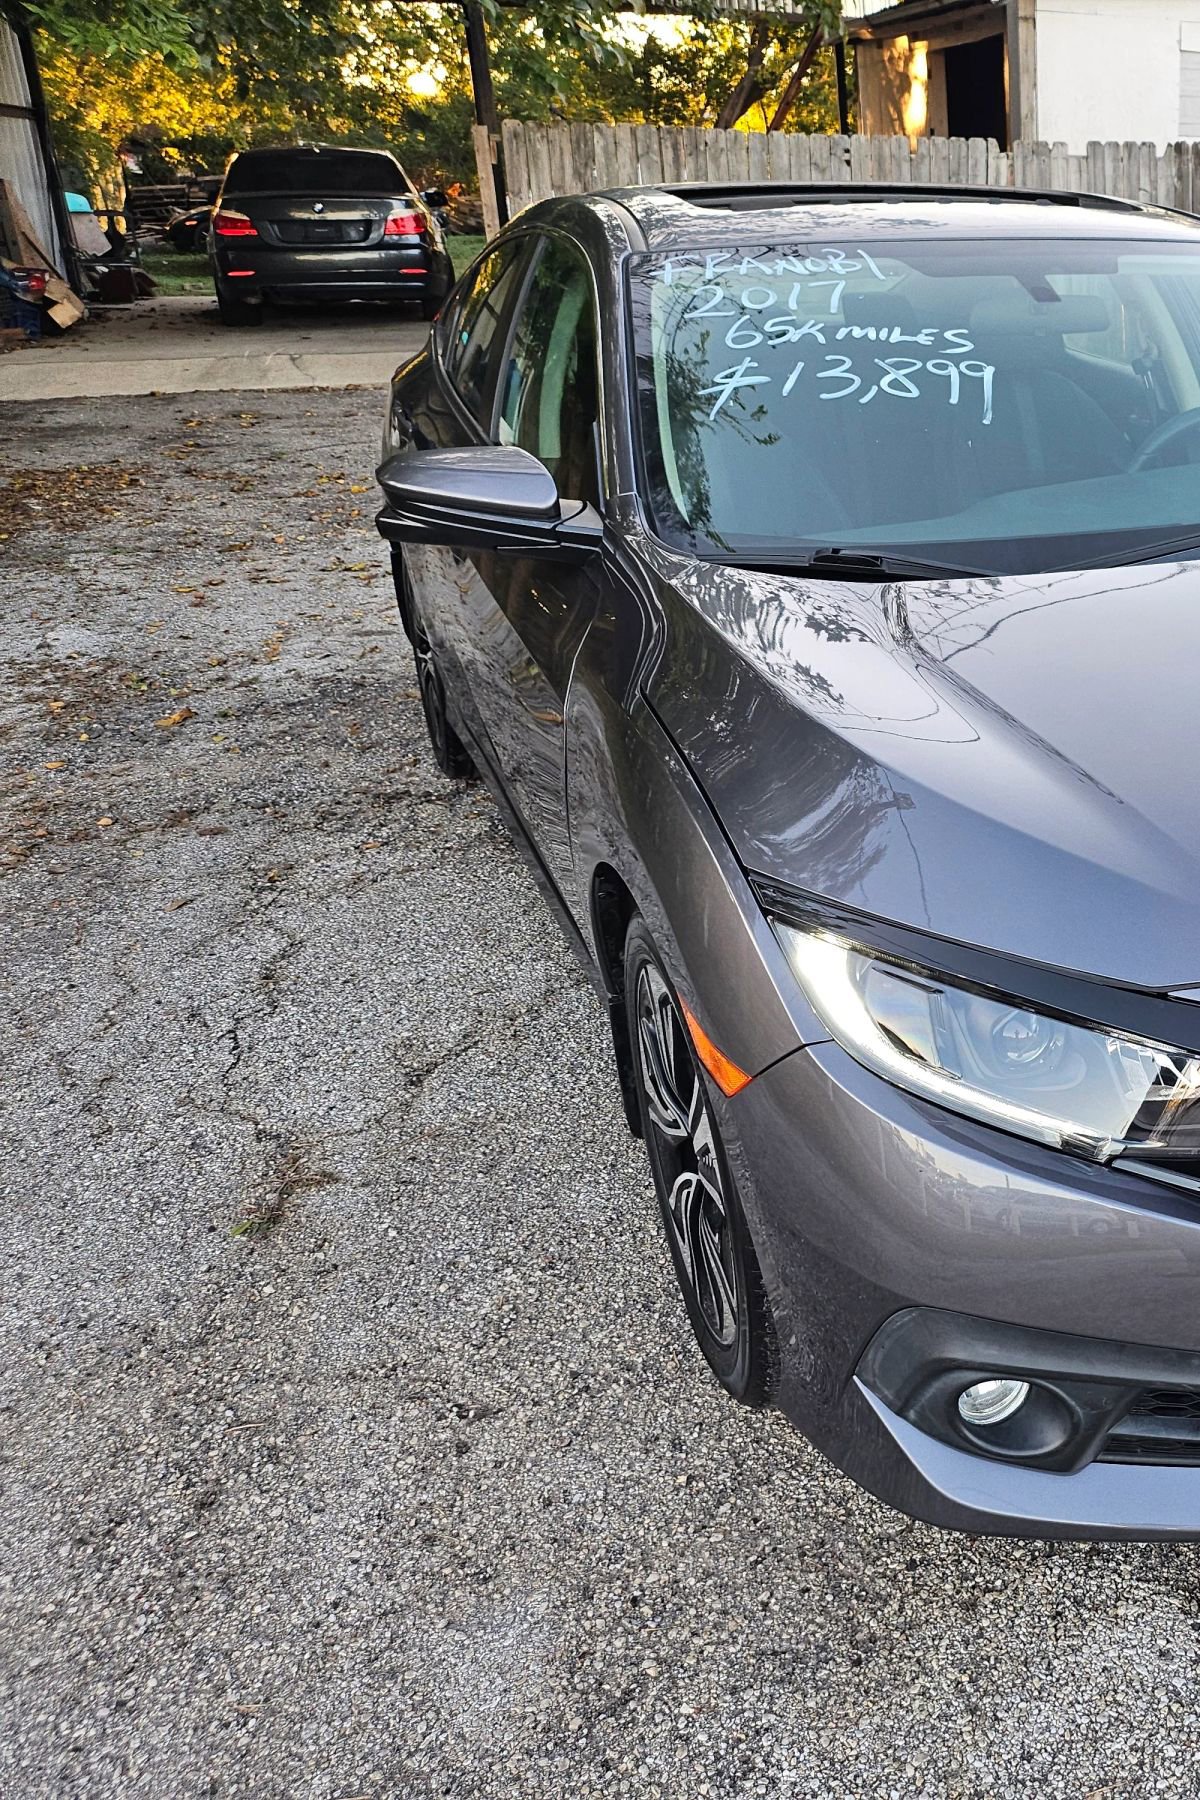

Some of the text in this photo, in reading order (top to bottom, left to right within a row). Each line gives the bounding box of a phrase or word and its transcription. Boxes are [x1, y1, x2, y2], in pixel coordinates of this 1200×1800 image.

[684, 279, 846, 318] 2017
[724, 314, 827, 349] 65K
[697, 354, 996, 424] $13,899
